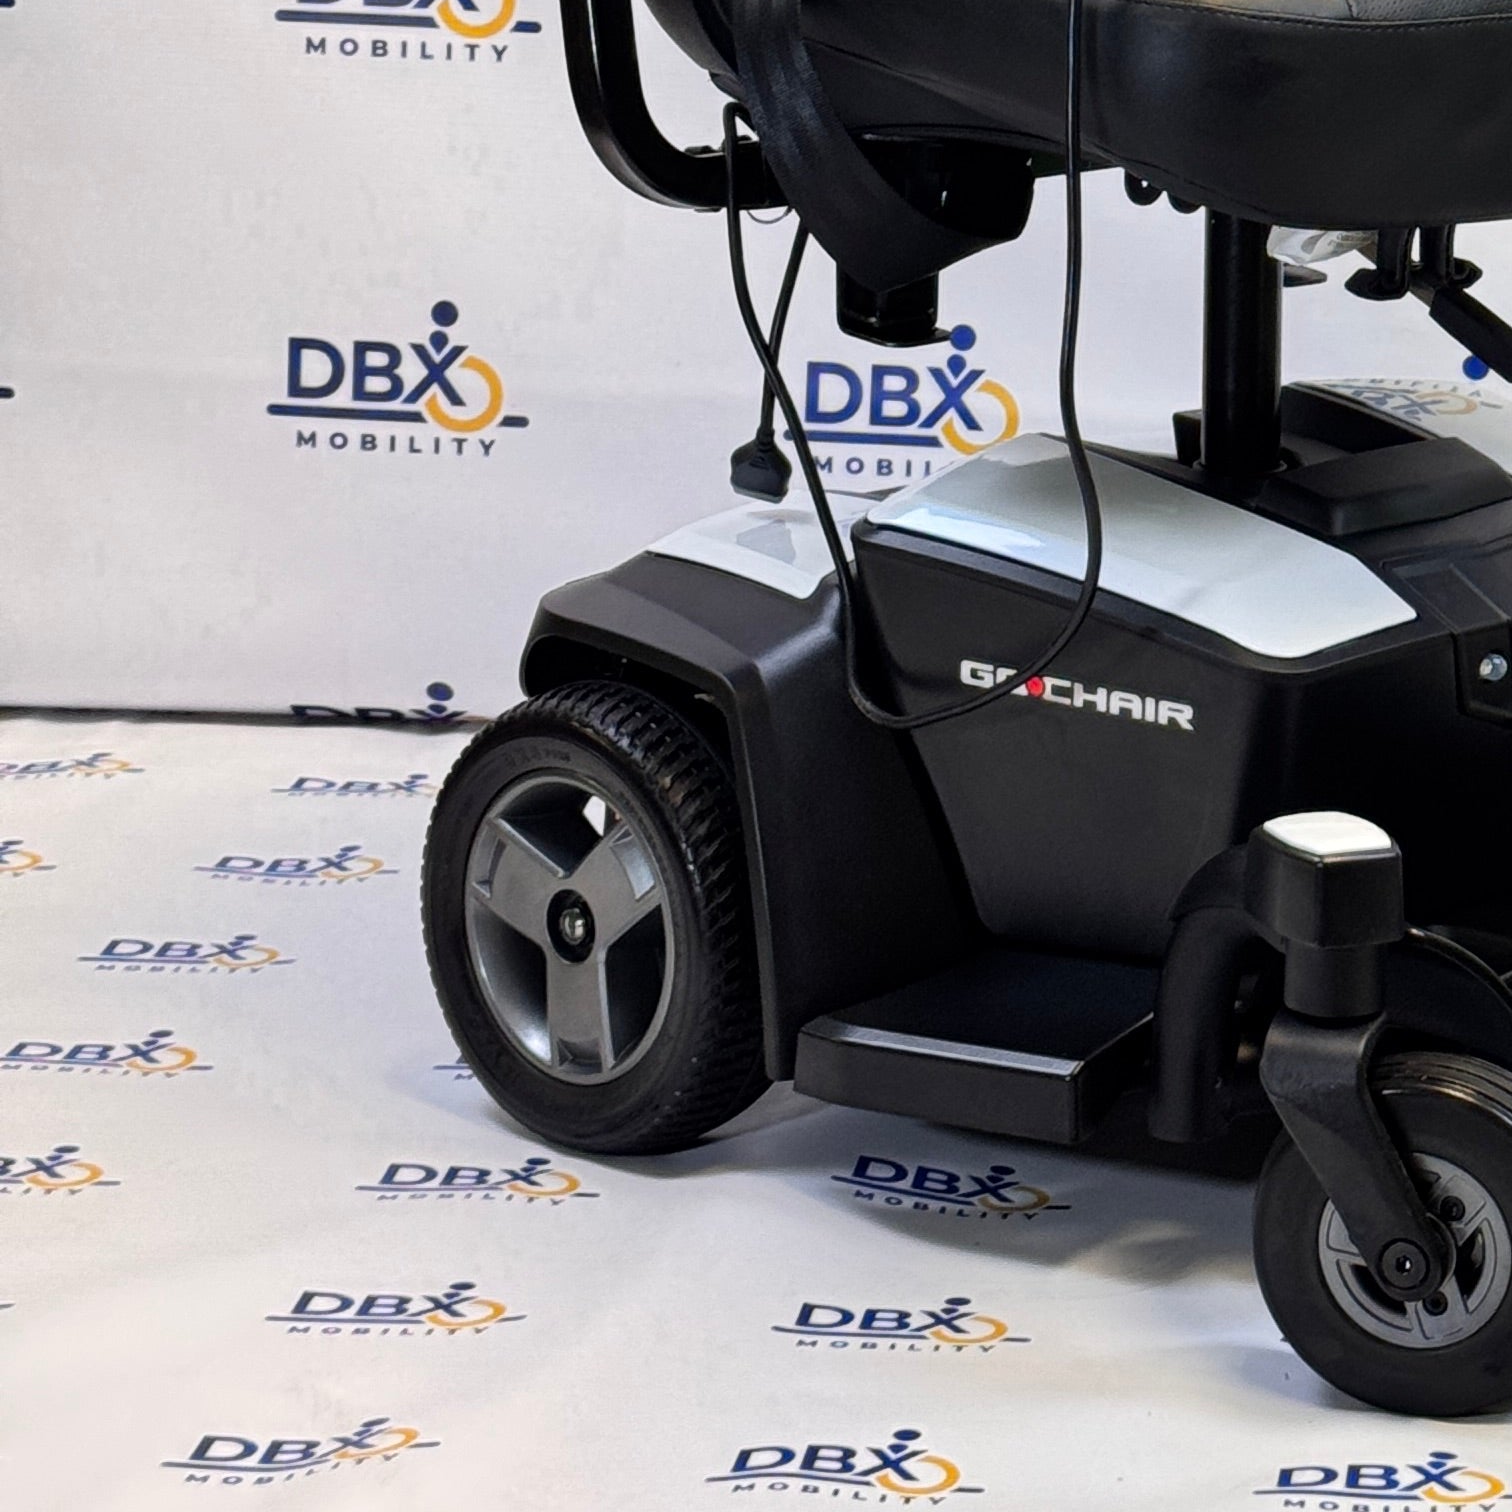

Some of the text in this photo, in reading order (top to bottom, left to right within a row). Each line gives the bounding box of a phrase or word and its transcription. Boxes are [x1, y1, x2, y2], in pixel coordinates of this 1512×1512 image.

[306, 37, 507, 61] MOBILITY
[287, 337, 468, 406] DBX
[804, 361, 986, 432] DBX
[297, 431, 494, 456] MOBILITY
[215, 855, 362, 872] DBX
[100, 939, 256, 960] DBX
[6, 1042, 176, 1063] DBX
[380, 1163, 553, 1186] DBX
[852, 1154, 1020, 1205] DBX
[854, 1190, 1044, 1221] MOBILITY
[291, 1290, 479, 1318] DBX
[795, 1301, 975, 1334] DBX
[287, 1325, 489, 1337] MOBILITY
[796, 1338, 996, 1354] MOBILITY
[189, 1427, 392, 1464] DBX
[731, 1444, 927, 1482] DBX
[1276, 1464, 1468, 1492] DBX
[731, 1482, 950, 1506] MOBILITY
